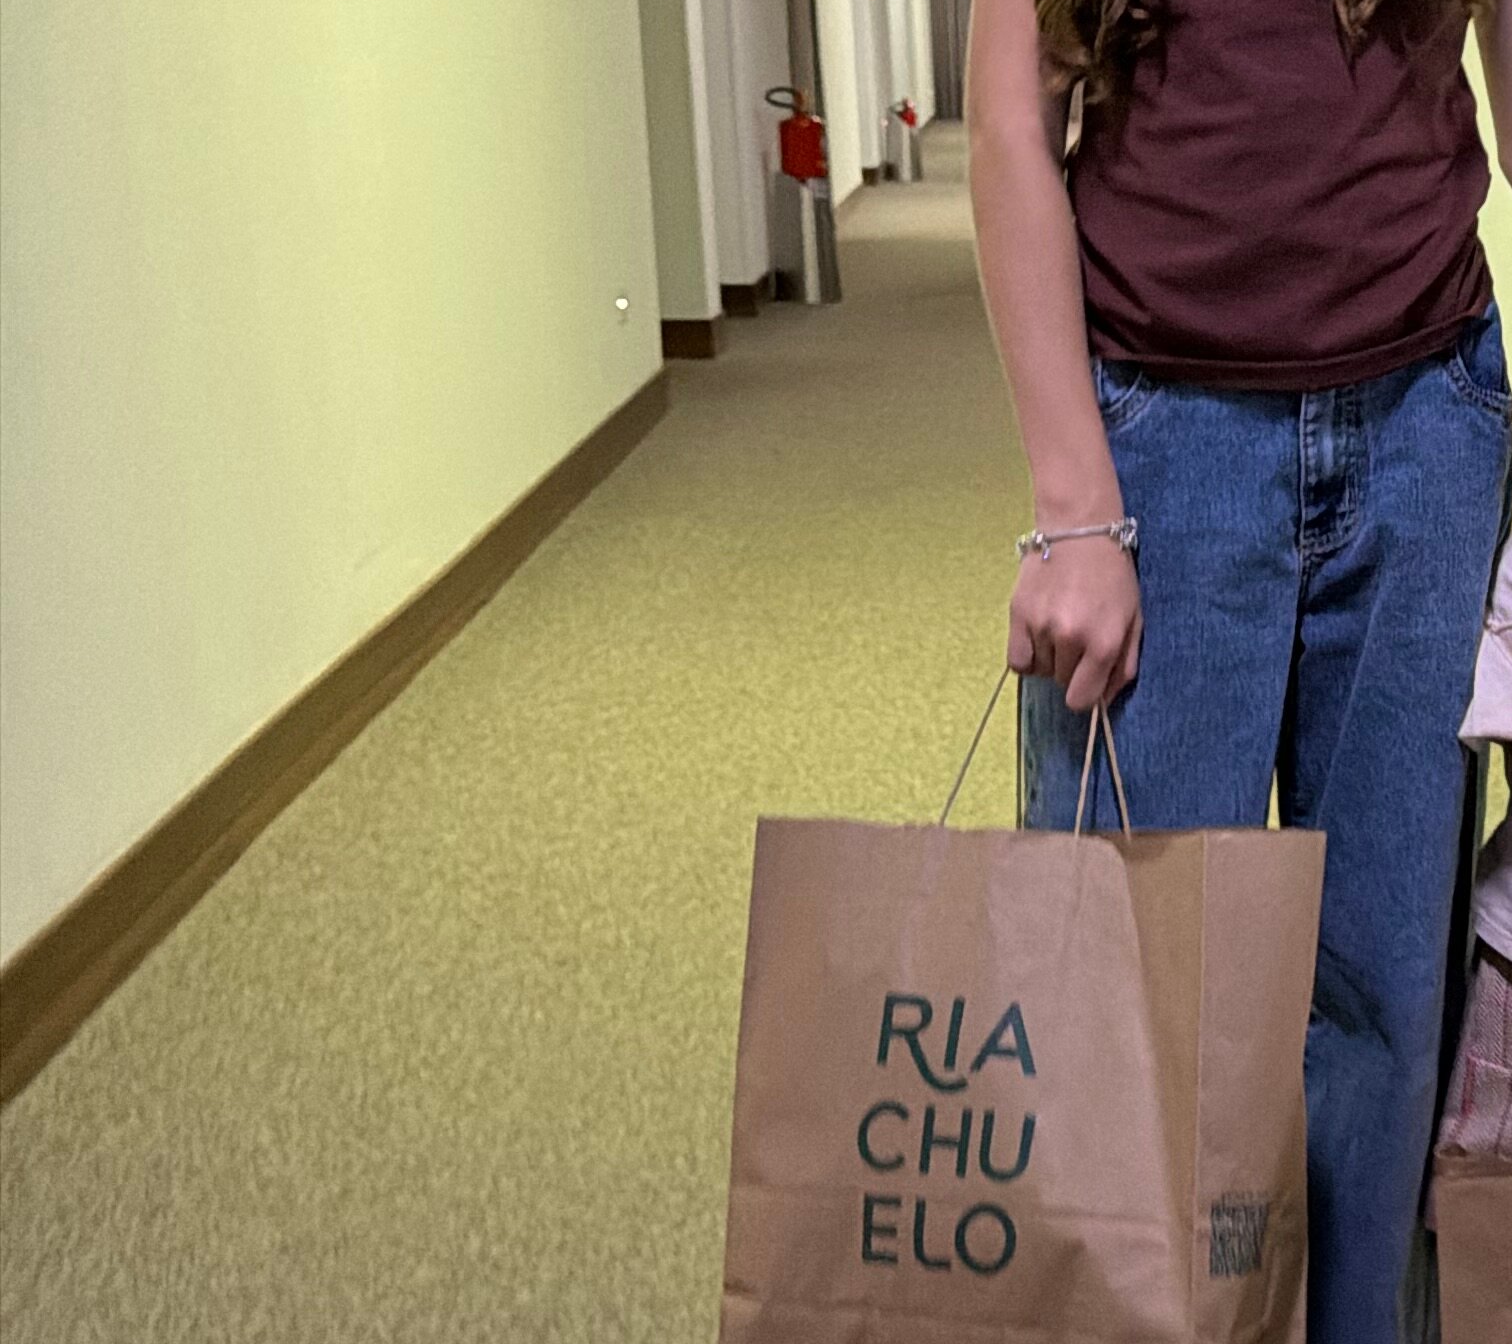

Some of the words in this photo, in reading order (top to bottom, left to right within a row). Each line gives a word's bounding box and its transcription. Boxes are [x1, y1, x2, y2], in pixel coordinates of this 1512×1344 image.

[877, 993, 1037, 1092] RIA
[857, 1101, 1036, 1182] CHU
[861, 1193, 1018, 1276] ELO
